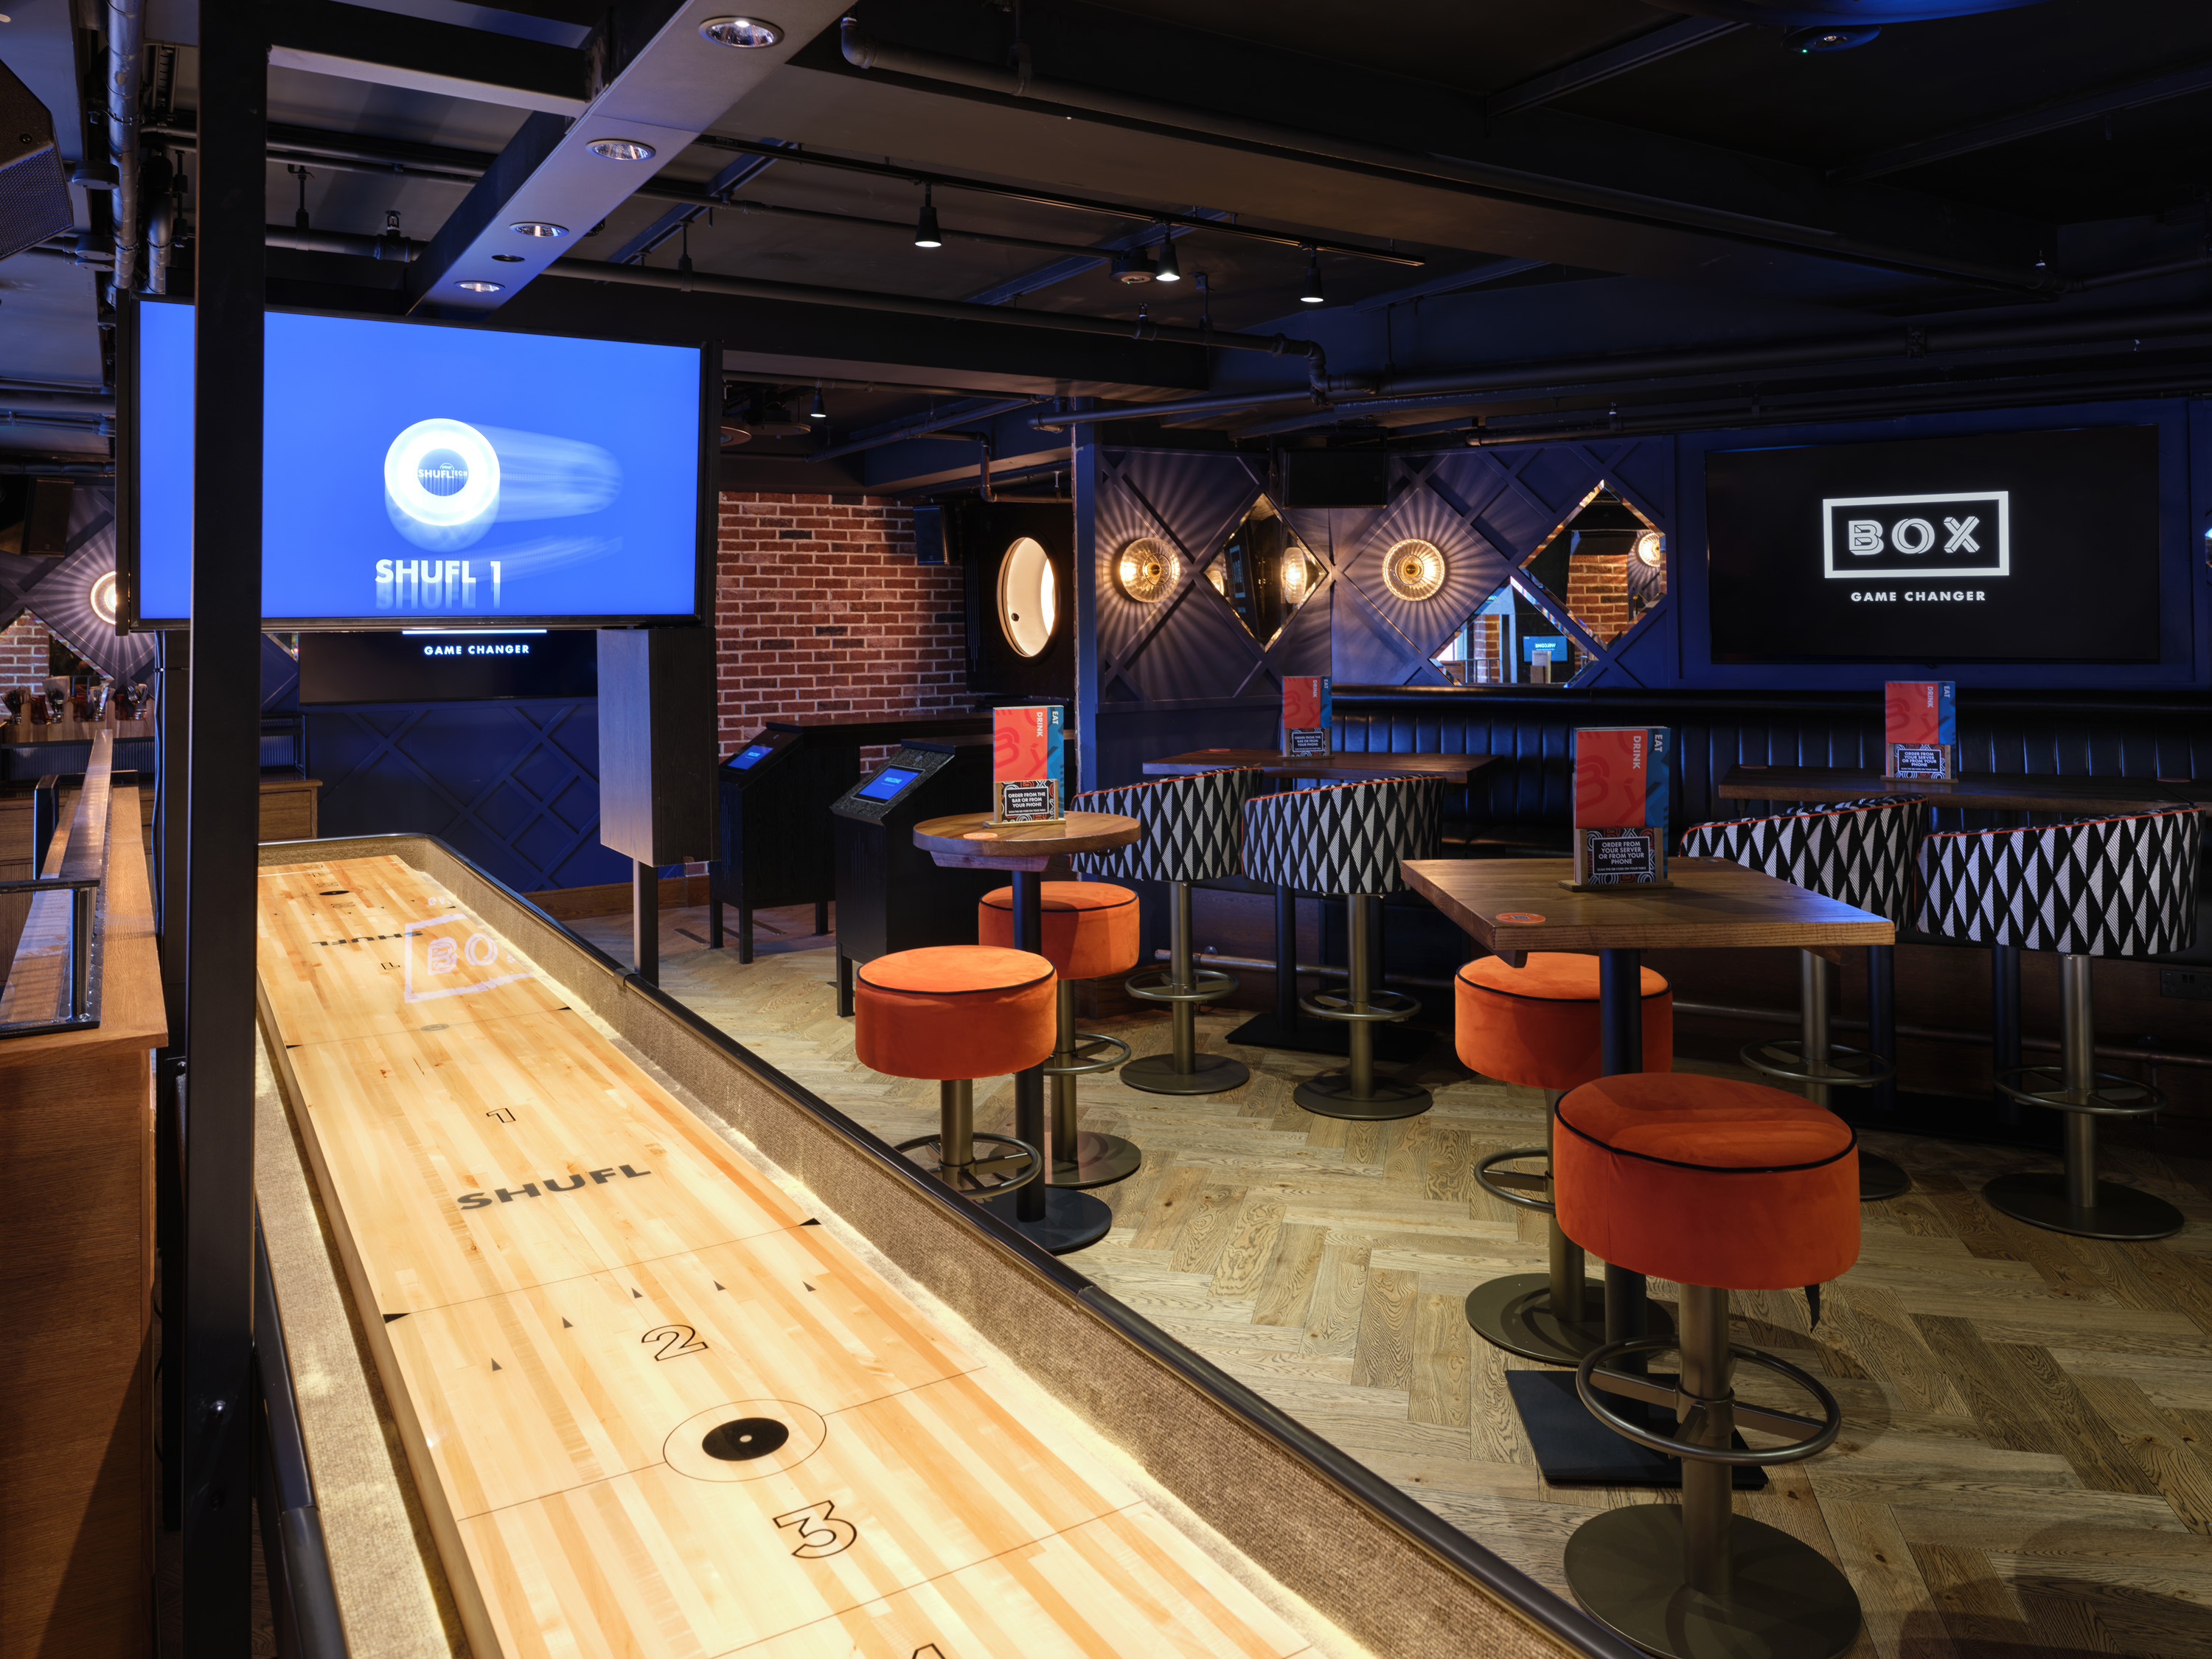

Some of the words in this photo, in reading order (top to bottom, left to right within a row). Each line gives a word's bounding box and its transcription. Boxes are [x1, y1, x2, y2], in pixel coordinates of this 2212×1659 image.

[1848, 516, 1980, 555] BOX
[375, 559, 476, 583] SHUFL
[490, 560, 501, 582] 1
[1851, 591, 1897, 602] GAME
[1904, 591, 1986, 602] CHANGER
[424, 646, 462, 655] GAME
[468, 644, 529, 654] CHANGER
[1633, 736, 1641, 770] DRINK
[1655, 734, 1663, 752] EAT
[486, 1107, 517, 1124] 1
[457, 1164, 652, 1211] SHUFL
[641, 1324, 709, 1361] 2
[772, 1500, 857, 1559] 3
